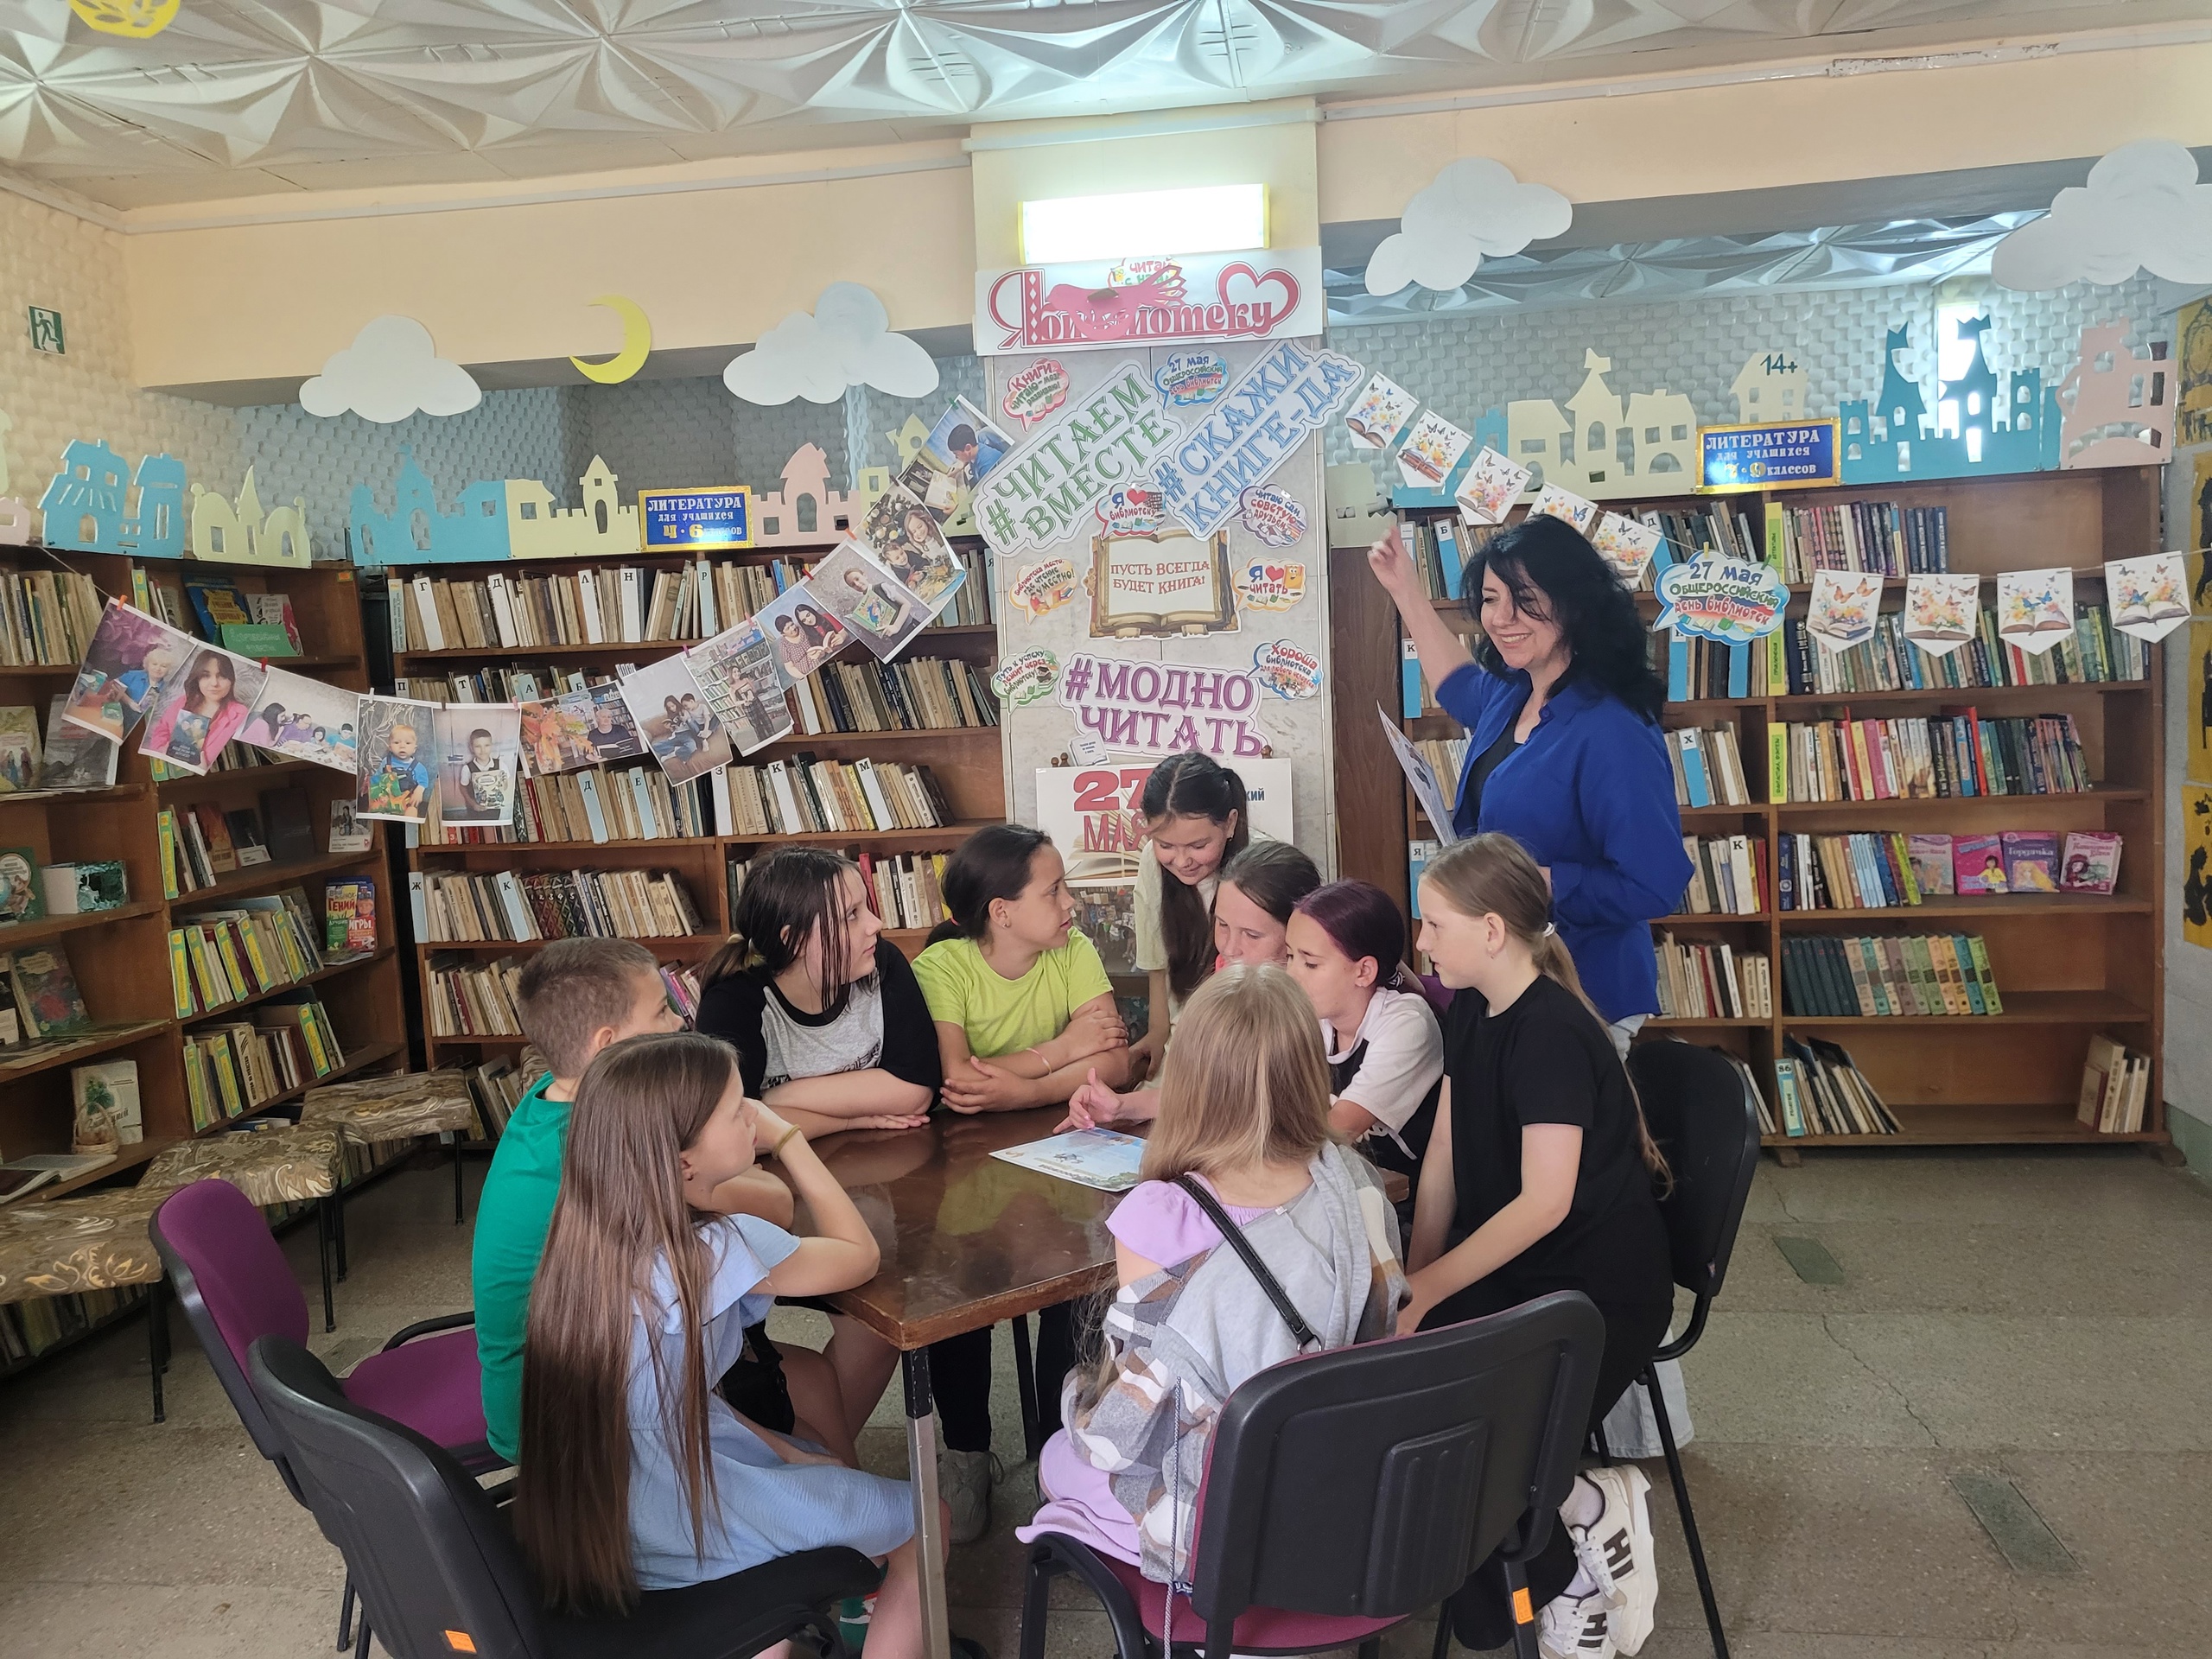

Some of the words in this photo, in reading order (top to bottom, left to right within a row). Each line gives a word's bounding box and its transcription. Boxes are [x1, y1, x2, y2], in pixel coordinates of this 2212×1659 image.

[990, 270, 1042, 347] Я
[1169, 358, 1180, 372] 27
[1760, 353, 1798, 376] 14+
[1154, 345, 1310, 504] #СКАЖИ
[1180, 359, 1358, 531] КНИГЕ-ДА
[1706, 429, 1821, 450] ЛИТЕРАТУРА
[986, 373, 1152, 546] #ЧИТАЕМ
[1716, 452, 1738, 461] ДЛЯ
[1747, 447, 1810, 459] УЧАЩИХСЯ
[1022, 411, 1173, 543] ВМЕСТЕ
[1767, 464, 1817, 476] КЛАССОВ
[647, 496, 742, 512] ЛИТЕРАТУРА
[1112, 493, 1125, 509] Я
[683, 512, 734, 521] УЧАЩИХСЯ
[1109, 507, 1156, 520] библиотеку
[1648, 518, 1656, 528] Д
[689, 524, 704, 538] 6
[1110, 563, 1153, 575] ПУСТЬ
[1156, 561, 1210, 575] ВСЕГДА
[1249, 565, 1262, 582] Я
[1689, 562, 1714, 581] 27
[493, 579, 502, 588] Д
[624, 572, 633, 581] Н
[419, 582, 428, 591] Г
[1113, 578, 1154, 594] БУДЕТ
[1158, 575, 1205, 594] КНИГА!
[1249, 583, 1288, 594] читать
[458, 679, 467, 690] Т
[525, 684, 533, 693] А
[1065, 658, 1253, 712] #МОДНО
[1080, 705, 1266, 757] ЧИТАТЬ
[772, 764, 782, 773] К
[859, 761, 869, 772] М
[584, 780, 592, 791] Д
[1073, 768, 1154, 811] 27
[1733, 840, 1743, 850] К
[411, 881, 422, 891] Ж
[503, 880, 511, 891] К
[349, 918, 372, 931] ИГРЫ
